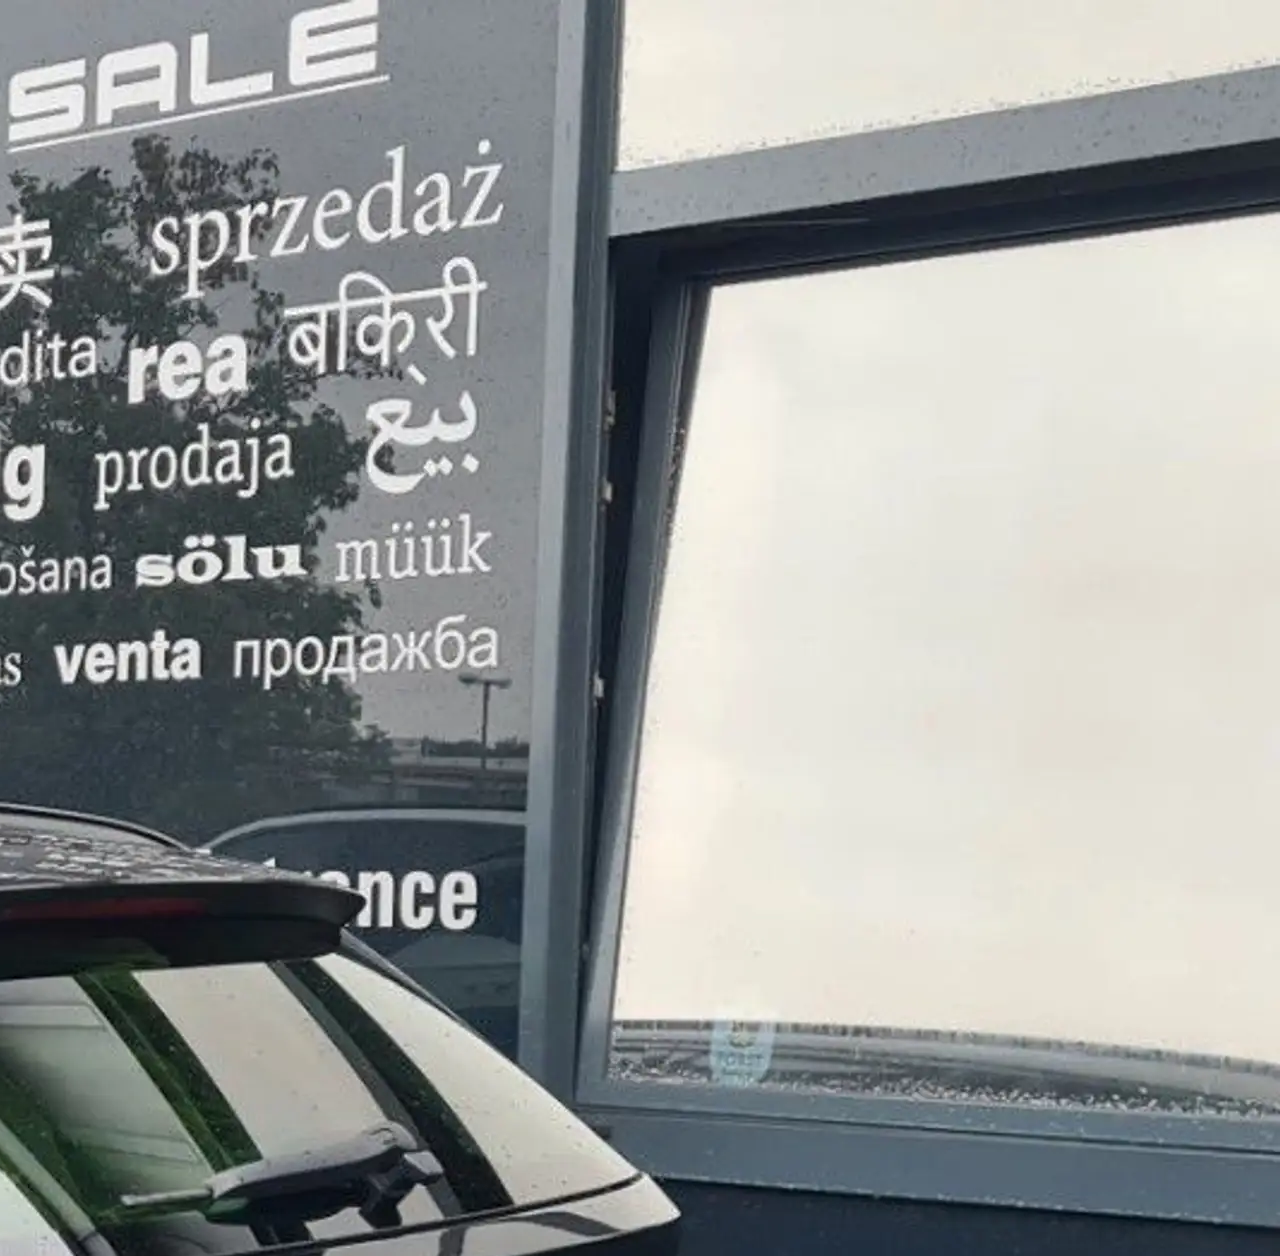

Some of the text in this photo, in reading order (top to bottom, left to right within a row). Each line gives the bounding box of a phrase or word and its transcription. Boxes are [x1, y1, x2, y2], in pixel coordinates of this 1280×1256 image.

[8, 0, 378, 142] SALE
[149, 139, 505, 298] sprzedaż
[128, 331, 248, 405] rea
[94, 417, 295, 511] prodaja
[366, 390, 480, 493] بيع
[135, 534, 308, 588] sölu
[335, 514, 493, 582] müük
[54, 630, 202, 685] venta
[233, 614, 500, 689] продажба
